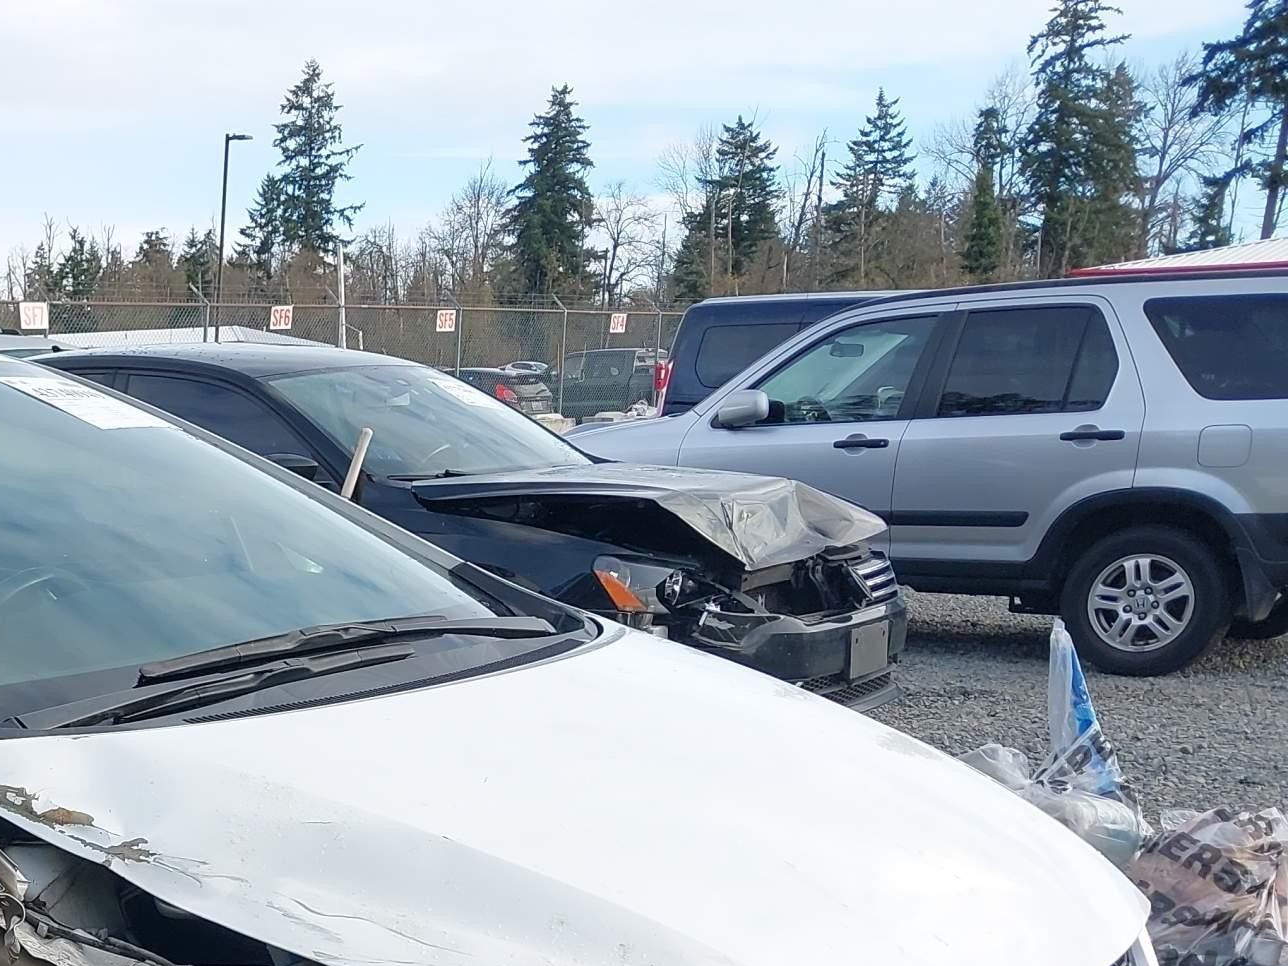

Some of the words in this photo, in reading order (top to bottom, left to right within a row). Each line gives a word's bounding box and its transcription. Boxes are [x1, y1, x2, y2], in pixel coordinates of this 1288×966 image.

[23, 305, 45, 326] SF7
[272, 307, 291, 328] SF6
[437, 314, 455, 330] SF5
[611, 315, 626, 331] SF4
